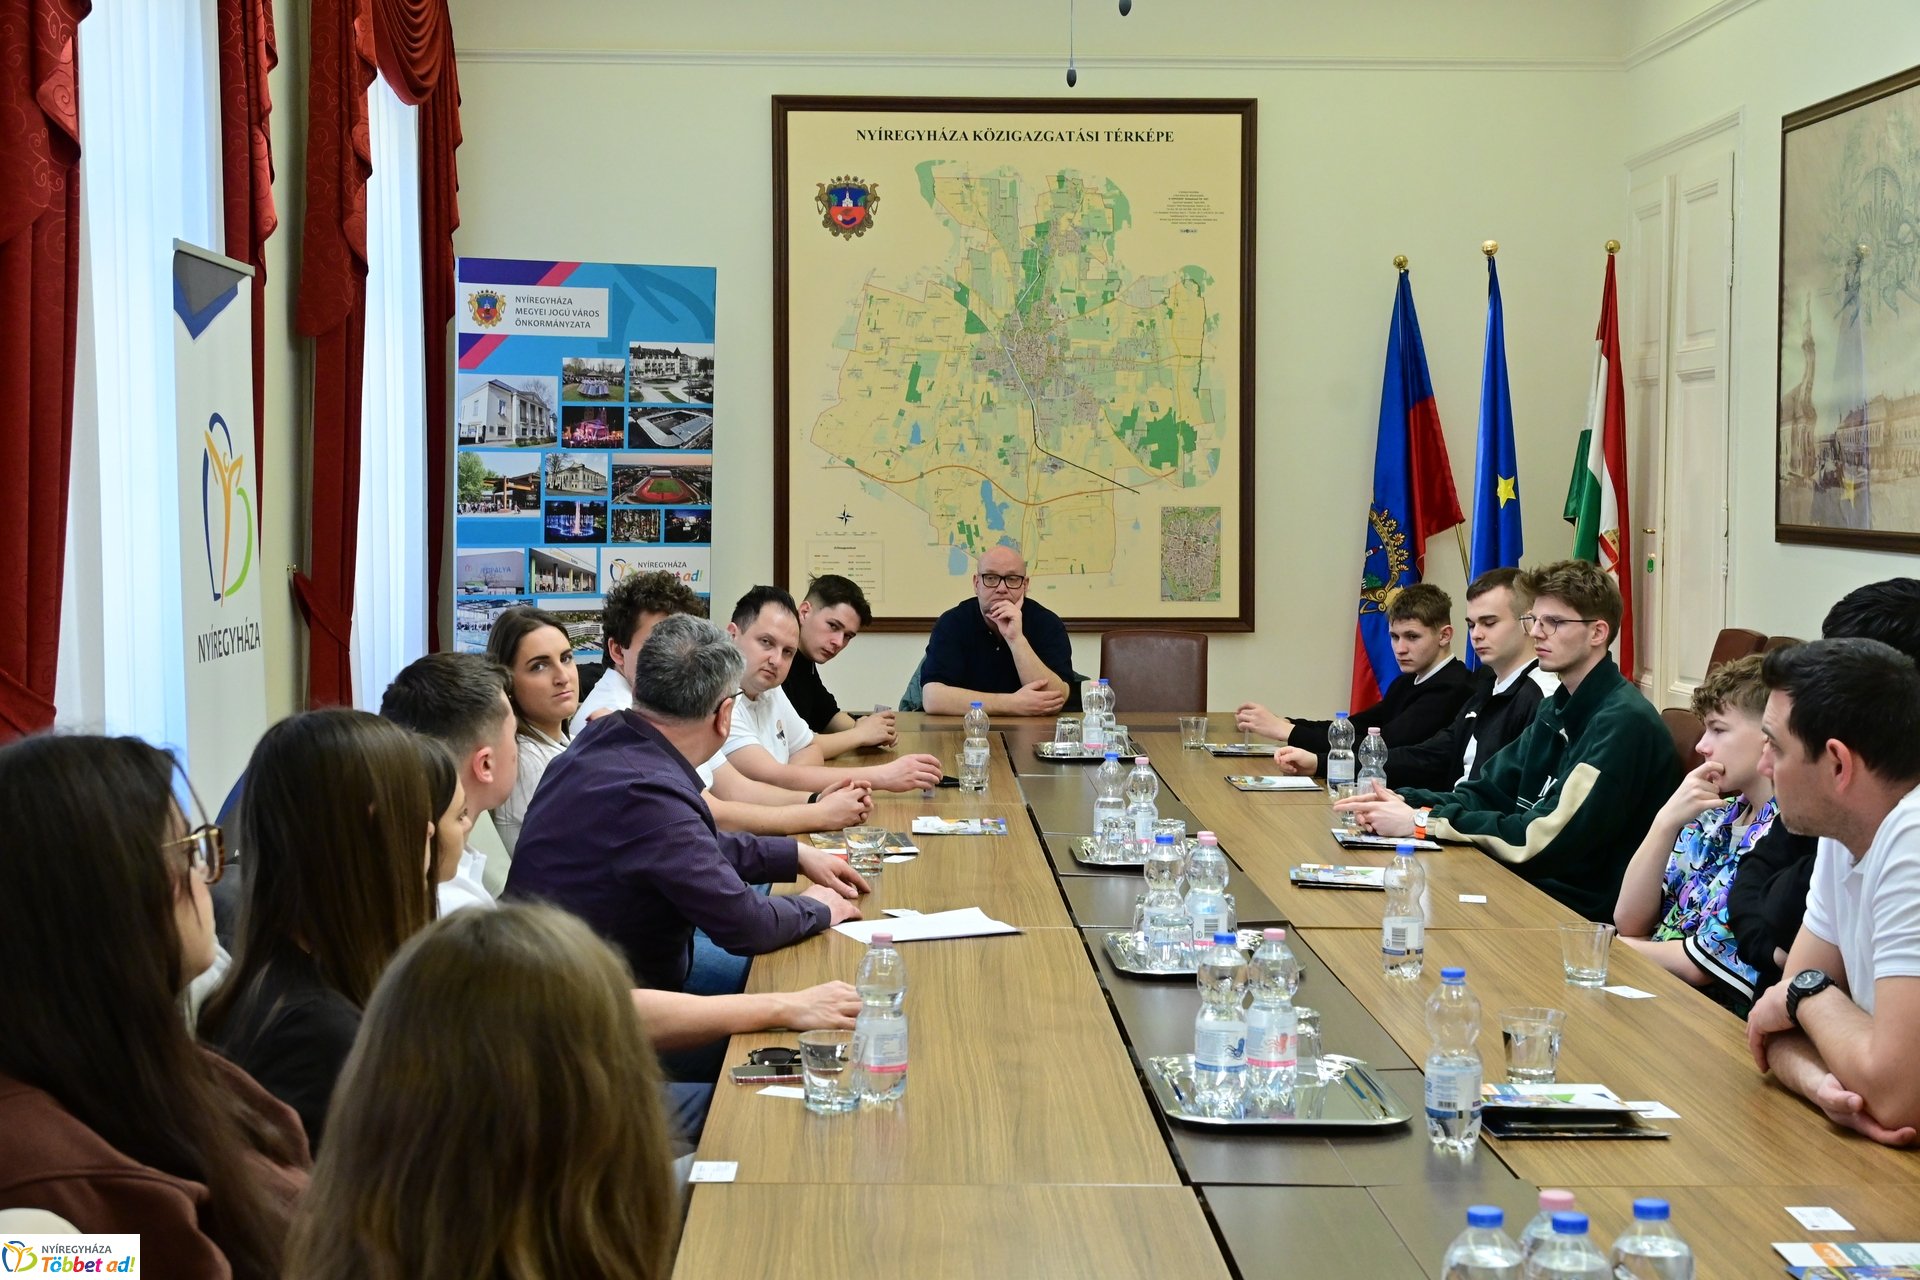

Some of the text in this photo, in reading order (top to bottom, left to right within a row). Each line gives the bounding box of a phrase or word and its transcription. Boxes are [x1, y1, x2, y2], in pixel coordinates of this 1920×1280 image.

[856, 127, 1175, 142] NYÍREGYHÁZA KÖZIGAZGATÁSI TÉRKÉPE
[515, 295, 573, 305] NYÍREGYHÁZA
[515, 307, 600, 318] MEGYEI JOGÚ VÁROS
[515, 317, 591, 329] ÖNKORMÁNYZATA
[637, 560, 687, 569] NYÍREGYHÁZA
[682, 569, 704, 582] ad!
[198, 616, 261, 663] NYÍREGYHÁZA
